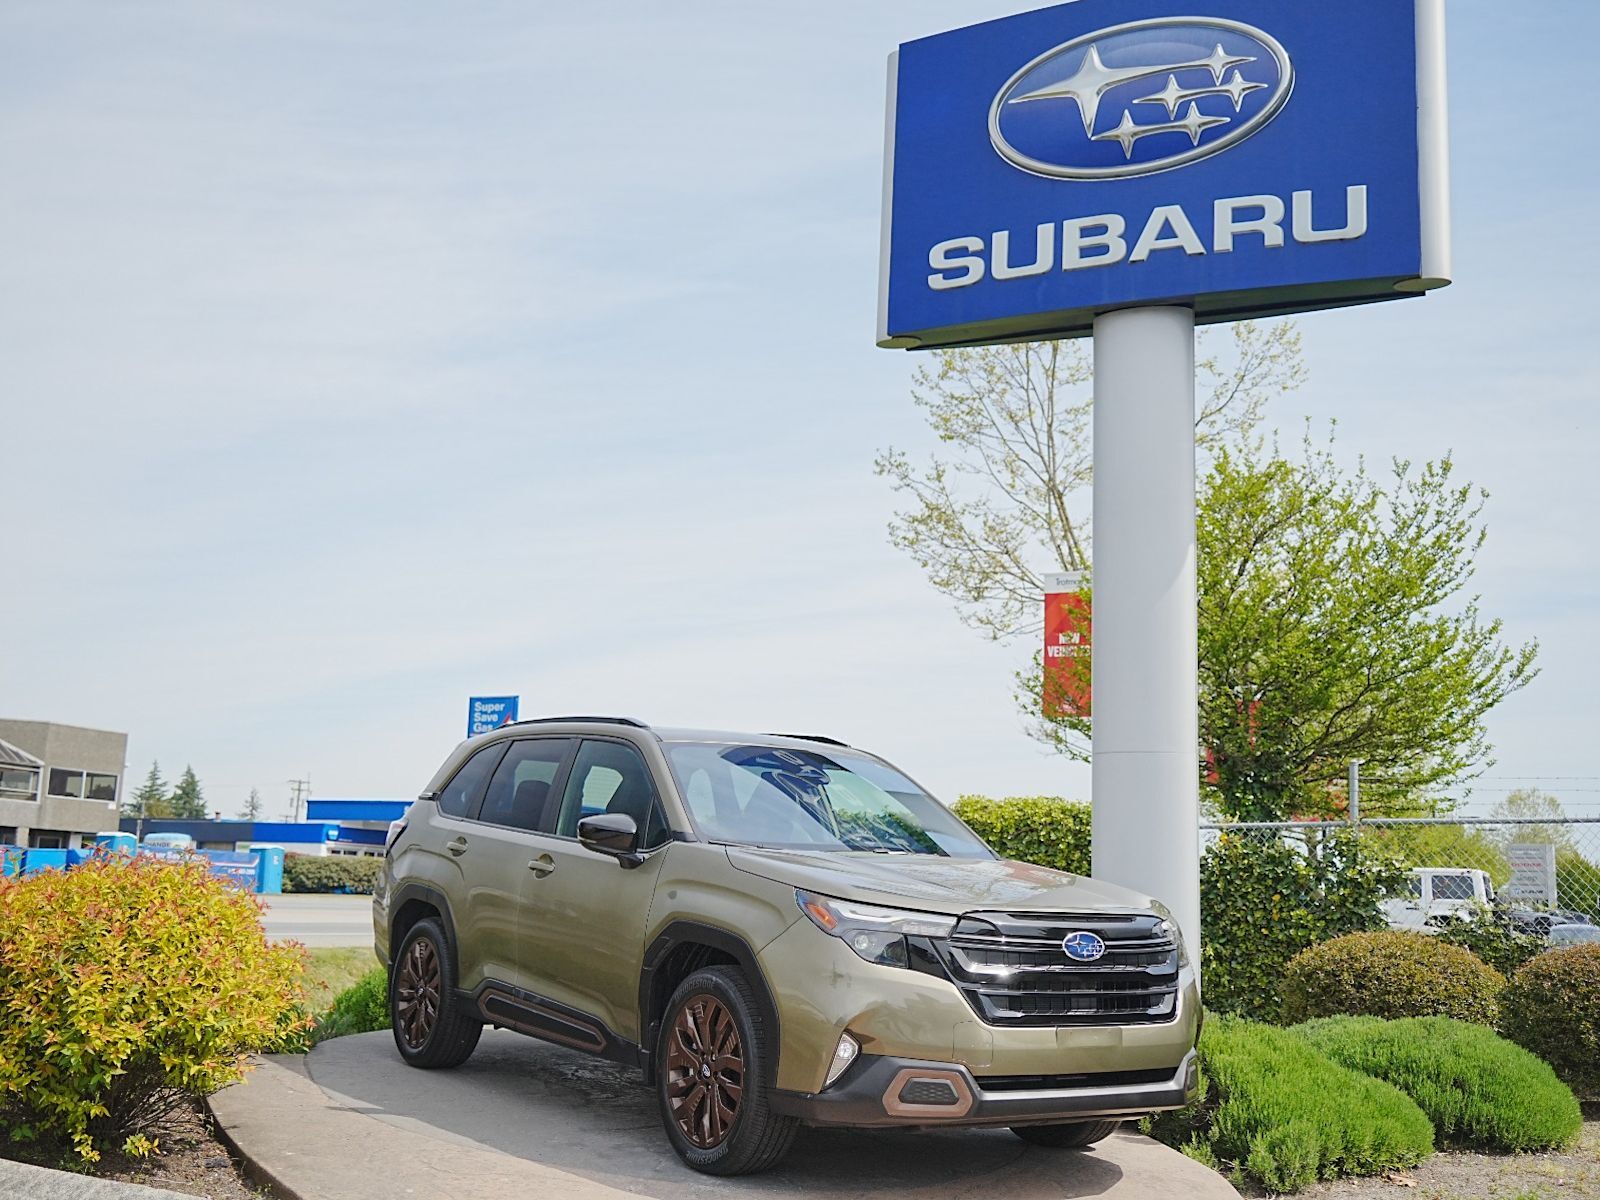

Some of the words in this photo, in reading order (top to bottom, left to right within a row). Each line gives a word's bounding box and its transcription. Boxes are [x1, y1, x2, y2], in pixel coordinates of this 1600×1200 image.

[928, 185, 1368, 290] SUBARU
[474, 702, 505, 713] Super
[473, 712, 499, 722] Save
[473, 722, 494, 732] Gas
